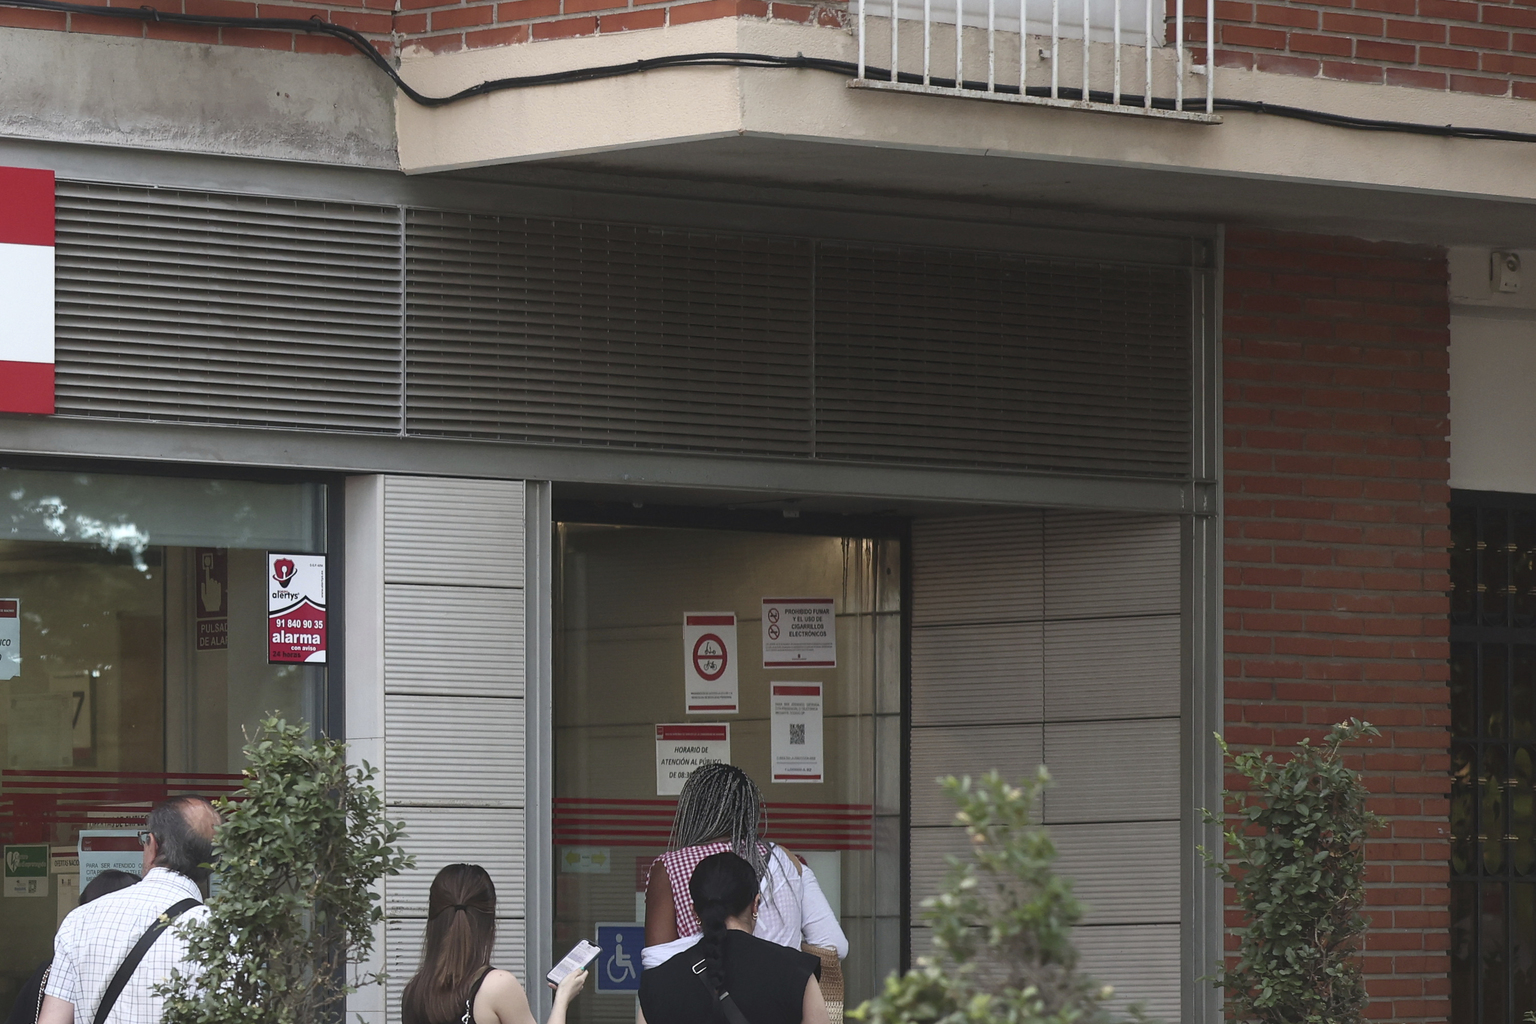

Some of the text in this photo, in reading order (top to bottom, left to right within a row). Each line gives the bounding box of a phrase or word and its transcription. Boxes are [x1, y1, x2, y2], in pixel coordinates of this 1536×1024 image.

[201, 622, 228, 633] PULSAD
[276, 618, 324, 629] 91 840 90 35
[272, 630, 321, 644] alarma
[661, 757, 690, 765] ATENCIÓN
[690, 758, 698, 766] AL
